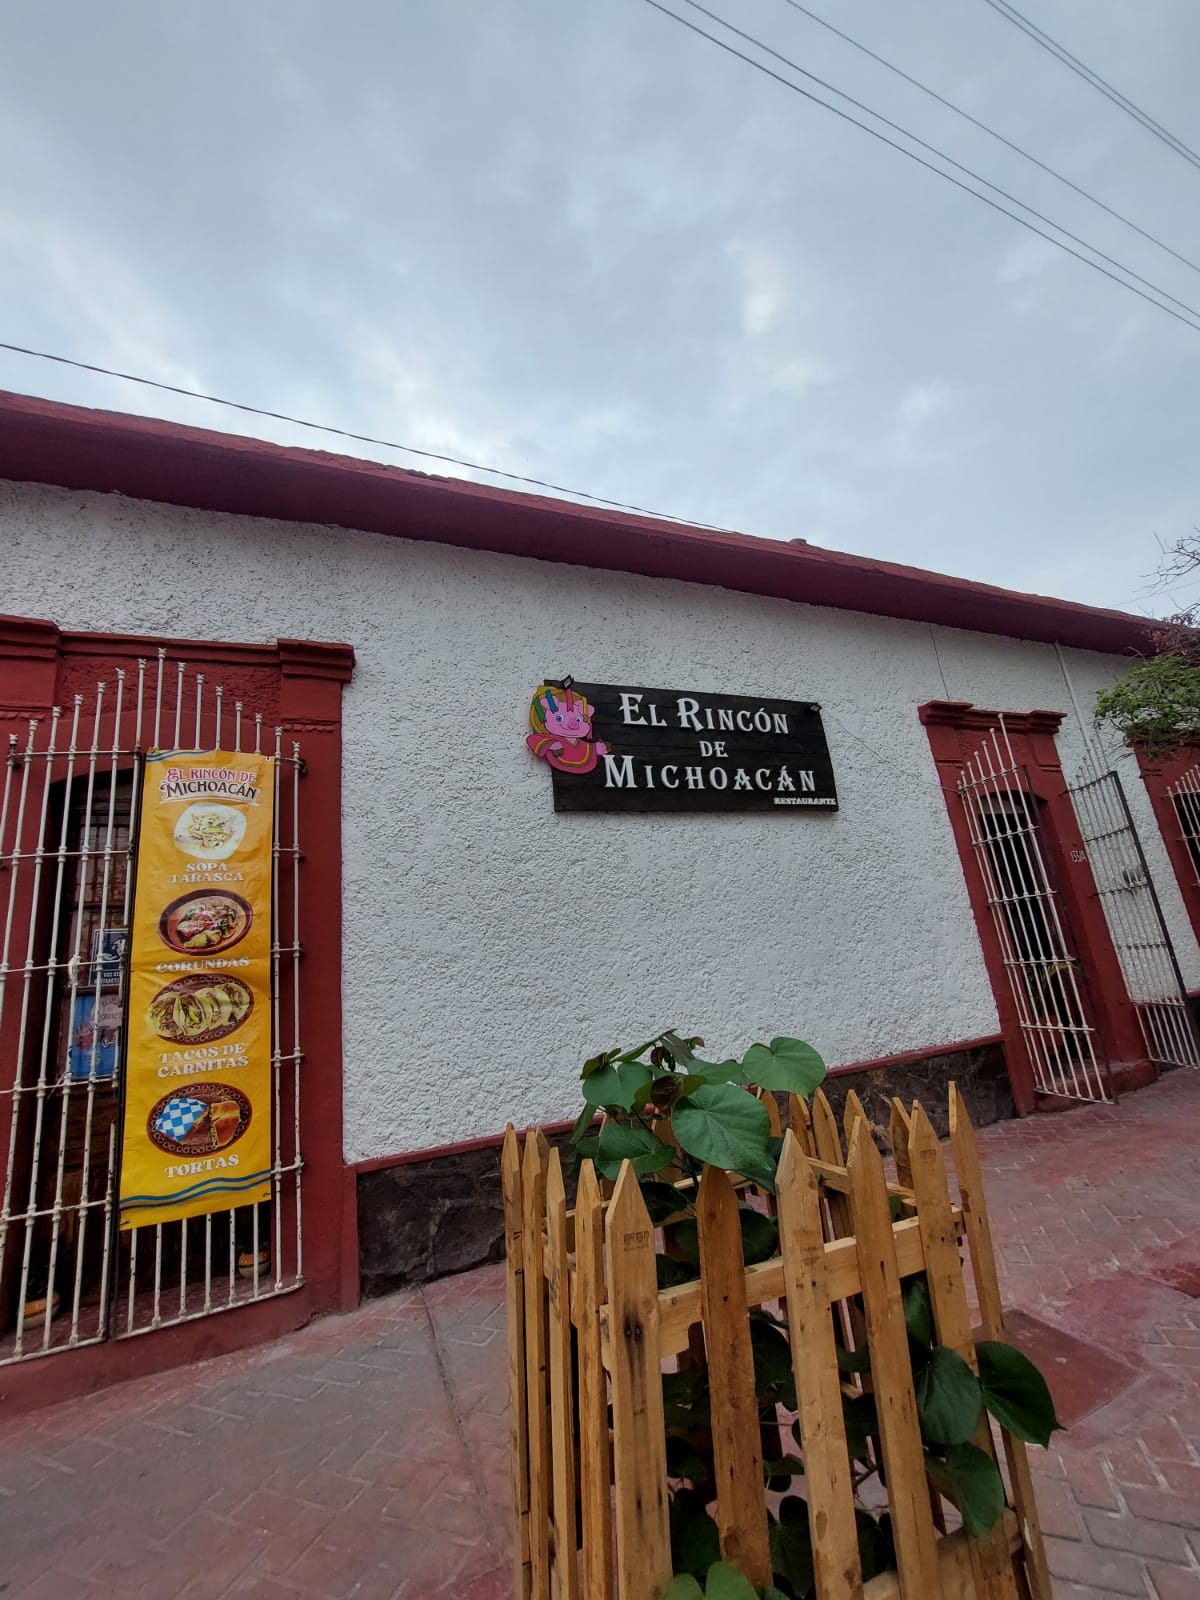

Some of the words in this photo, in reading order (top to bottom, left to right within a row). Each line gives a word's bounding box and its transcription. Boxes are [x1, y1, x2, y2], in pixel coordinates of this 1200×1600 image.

[618, 692, 668, 727] EL
[676, 697, 789, 735] RINCÓN
[699, 740, 729, 758] DE
[167, 768, 186, 783] EL
[190, 768, 236, 780] RINCÓN
[240, 772, 257, 783] DE
[603, 754, 817, 792] MICHOACÁN
[160, 780, 257, 799] MICHOACÁN
[773, 797, 837, 805] RESTAURANTE
[185, 862, 228, 873] SOPA
[169, 872, 245, 884] TARASCA
[156, 956, 250, 973] CORUNDAS
[158, 1046, 219, 1064] TACOS
[222, 1042, 246, 1056] DE
[157, 1055, 249, 1078] CARNITAS
[164, 1154, 240, 1178] TORTAS
